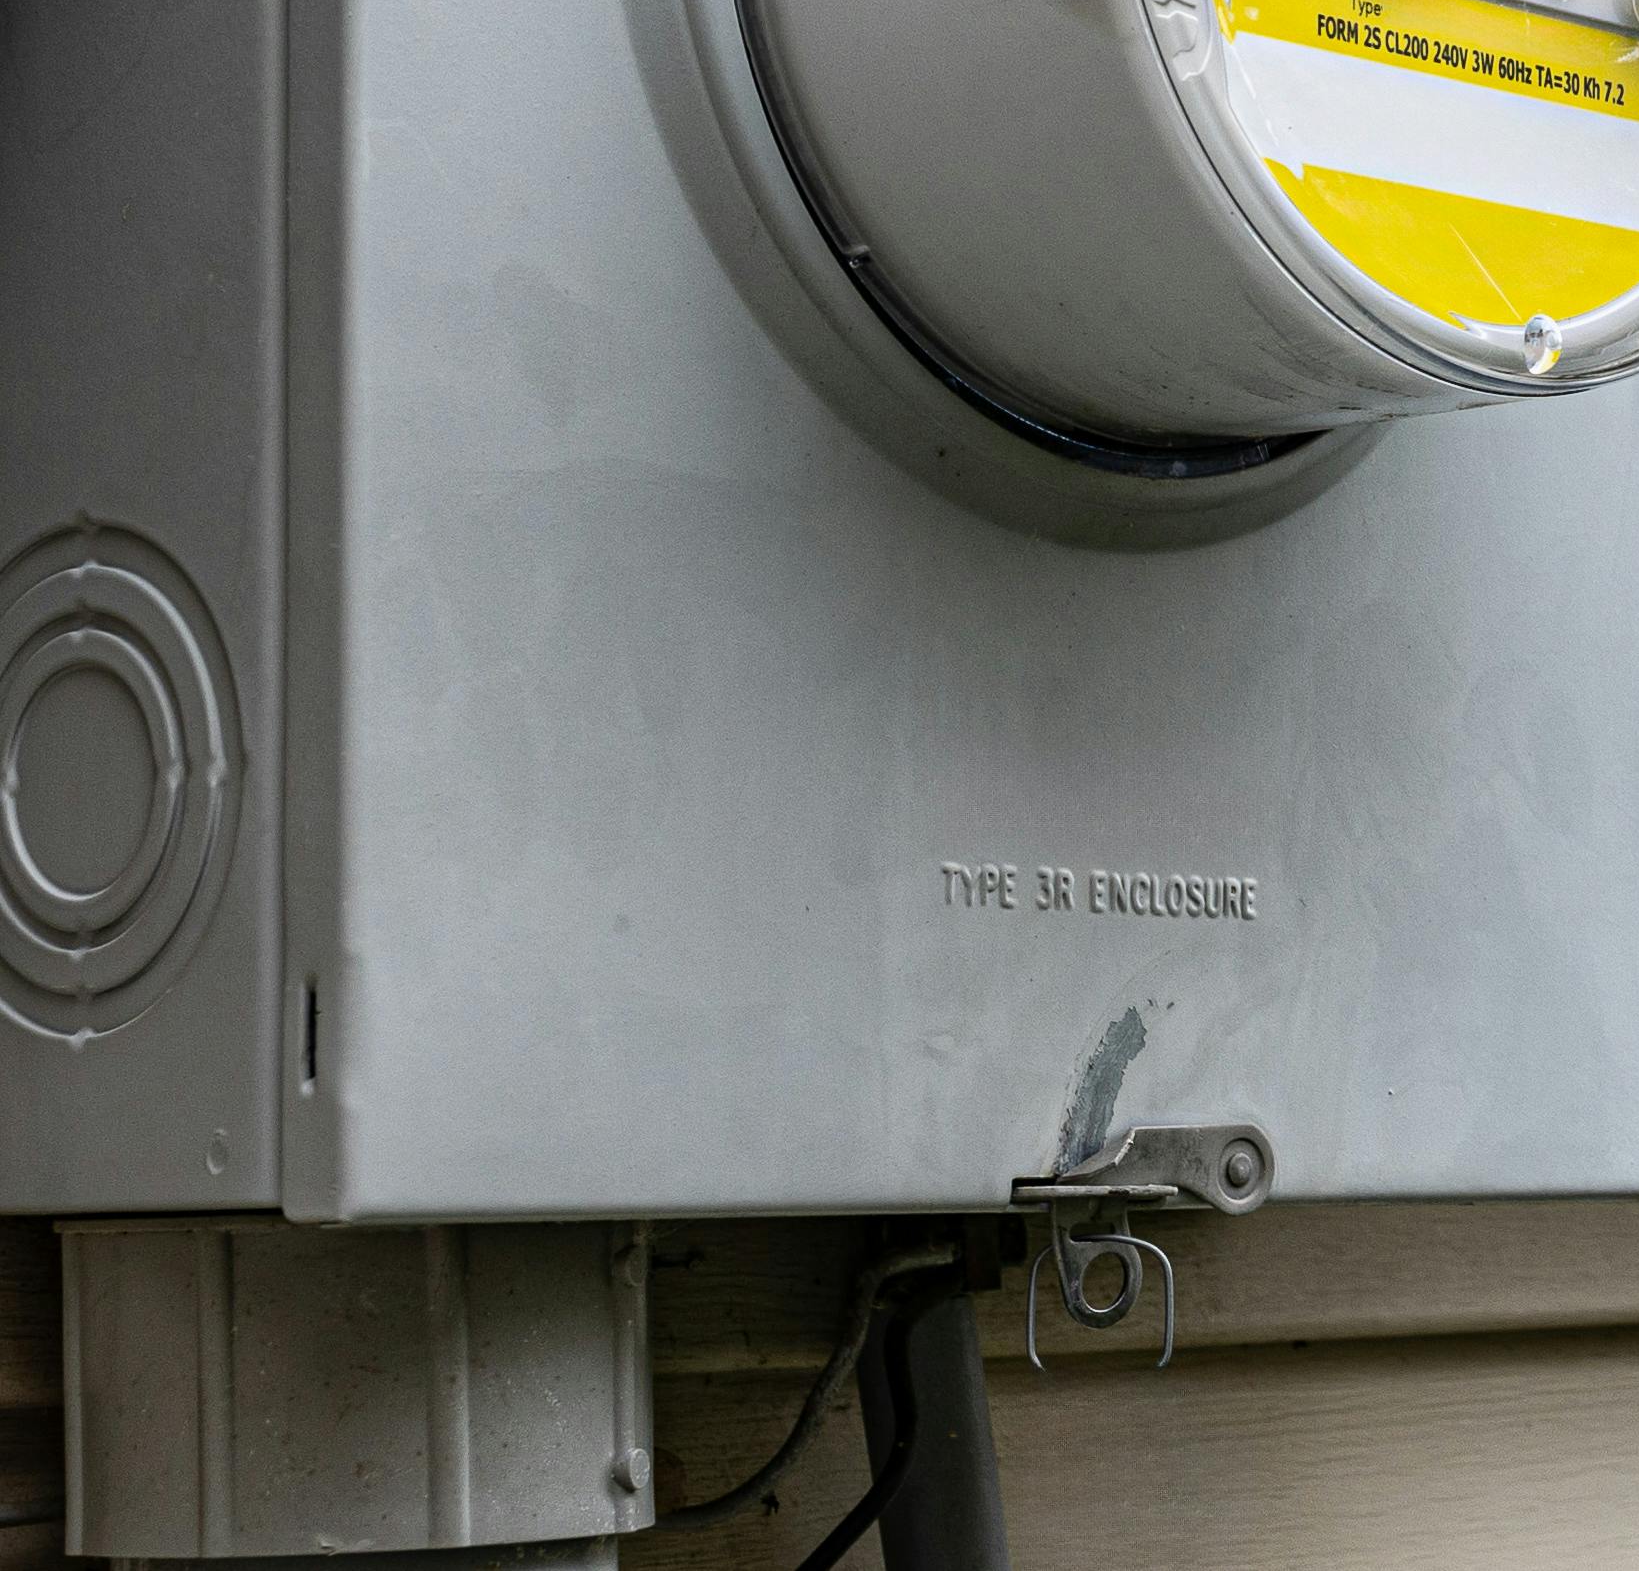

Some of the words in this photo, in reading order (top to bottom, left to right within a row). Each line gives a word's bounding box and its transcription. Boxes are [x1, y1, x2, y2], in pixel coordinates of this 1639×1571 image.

[1317, 13, 1359, 45] FORM
[1363, 24, 1382, 50] 2S
[1385, 29, 1429, 61] CL200
[1433, 40, 1469, 70] 240V
[1472, 50, 1494, 76] 3W
[1498, 56, 1533, 85] 60Hz
[1536, 65, 1580, 96] TA=30
[1583, 75, 1601, 101] Kh
[1604, 81, 1625, 106] 7.2
[940, 861, 1019, 911] TYPE
[1035, 866, 1078, 913] 3R
[1089, 869, 1260, 922] ENCLOSURE
